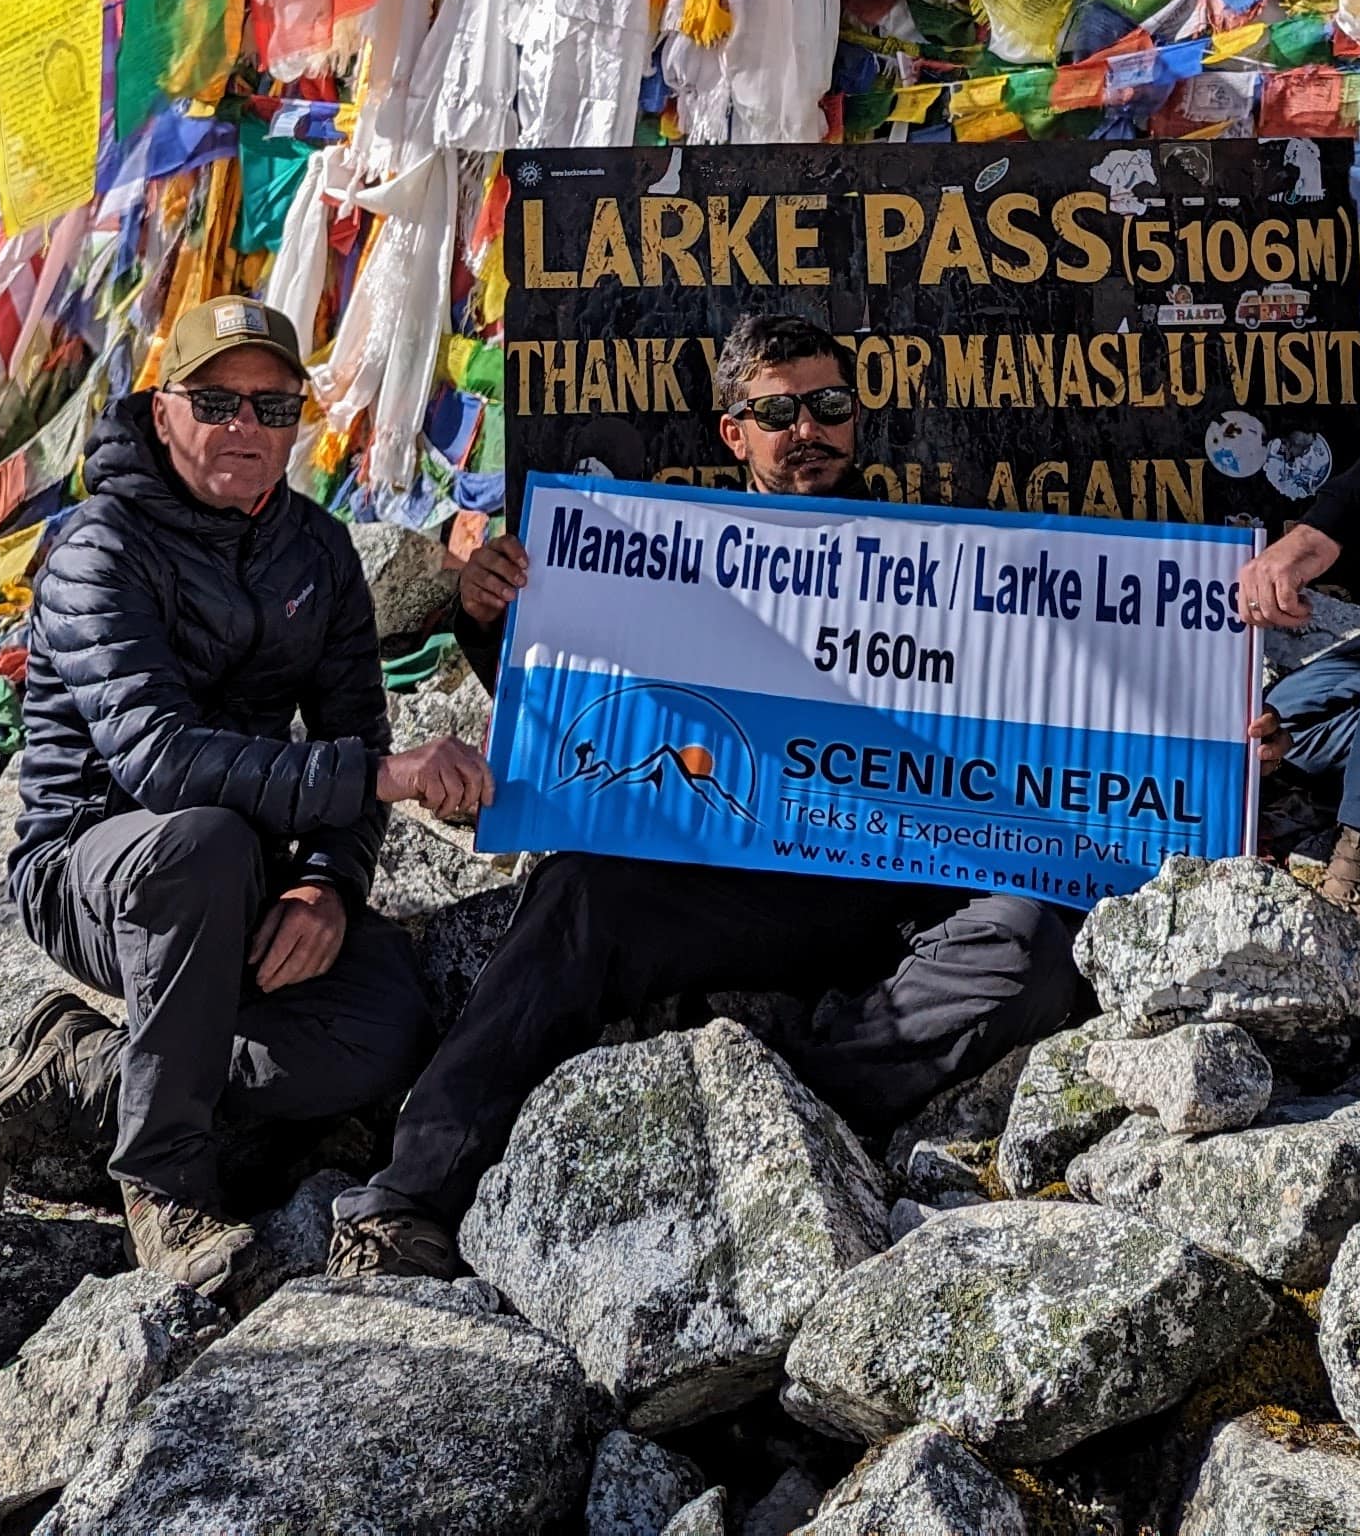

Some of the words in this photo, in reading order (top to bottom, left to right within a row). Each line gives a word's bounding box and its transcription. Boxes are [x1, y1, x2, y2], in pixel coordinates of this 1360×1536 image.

[522, 193, 831, 289] LARKE
[861, 190, 1114, 285] PASS
[1121, 205, 1353, 287] (5106M)
[507, 336, 692, 416] THANK
[941, 331, 1208, 409] MANASLU
[986, 457, 1208, 525] AGAIN
[546, 505, 704, 585] Manaslu
[714, 523, 843, 600] Circuit
[855, 535, 941, 609] Trek
[948, 542, 964, 611] /
[972, 545, 1083, 621] Larke
[1095, 554, 1142, 626] La
[1155, 559, 1247, 634] Pass
[813, 625, 956, 685] 5160m
[781, 737, 998, 803] SCENIC
[1014, 763, 1203, 824] NEPAL
[771, 839, 1140, 898] www.scenicnepaltreks
[780, 797, 858, 832] Treks
[866, 809, 890, 835] &
[897, 814, 1065, 858] Expedition
[1074, 834, 1131, 865] Pvt.
